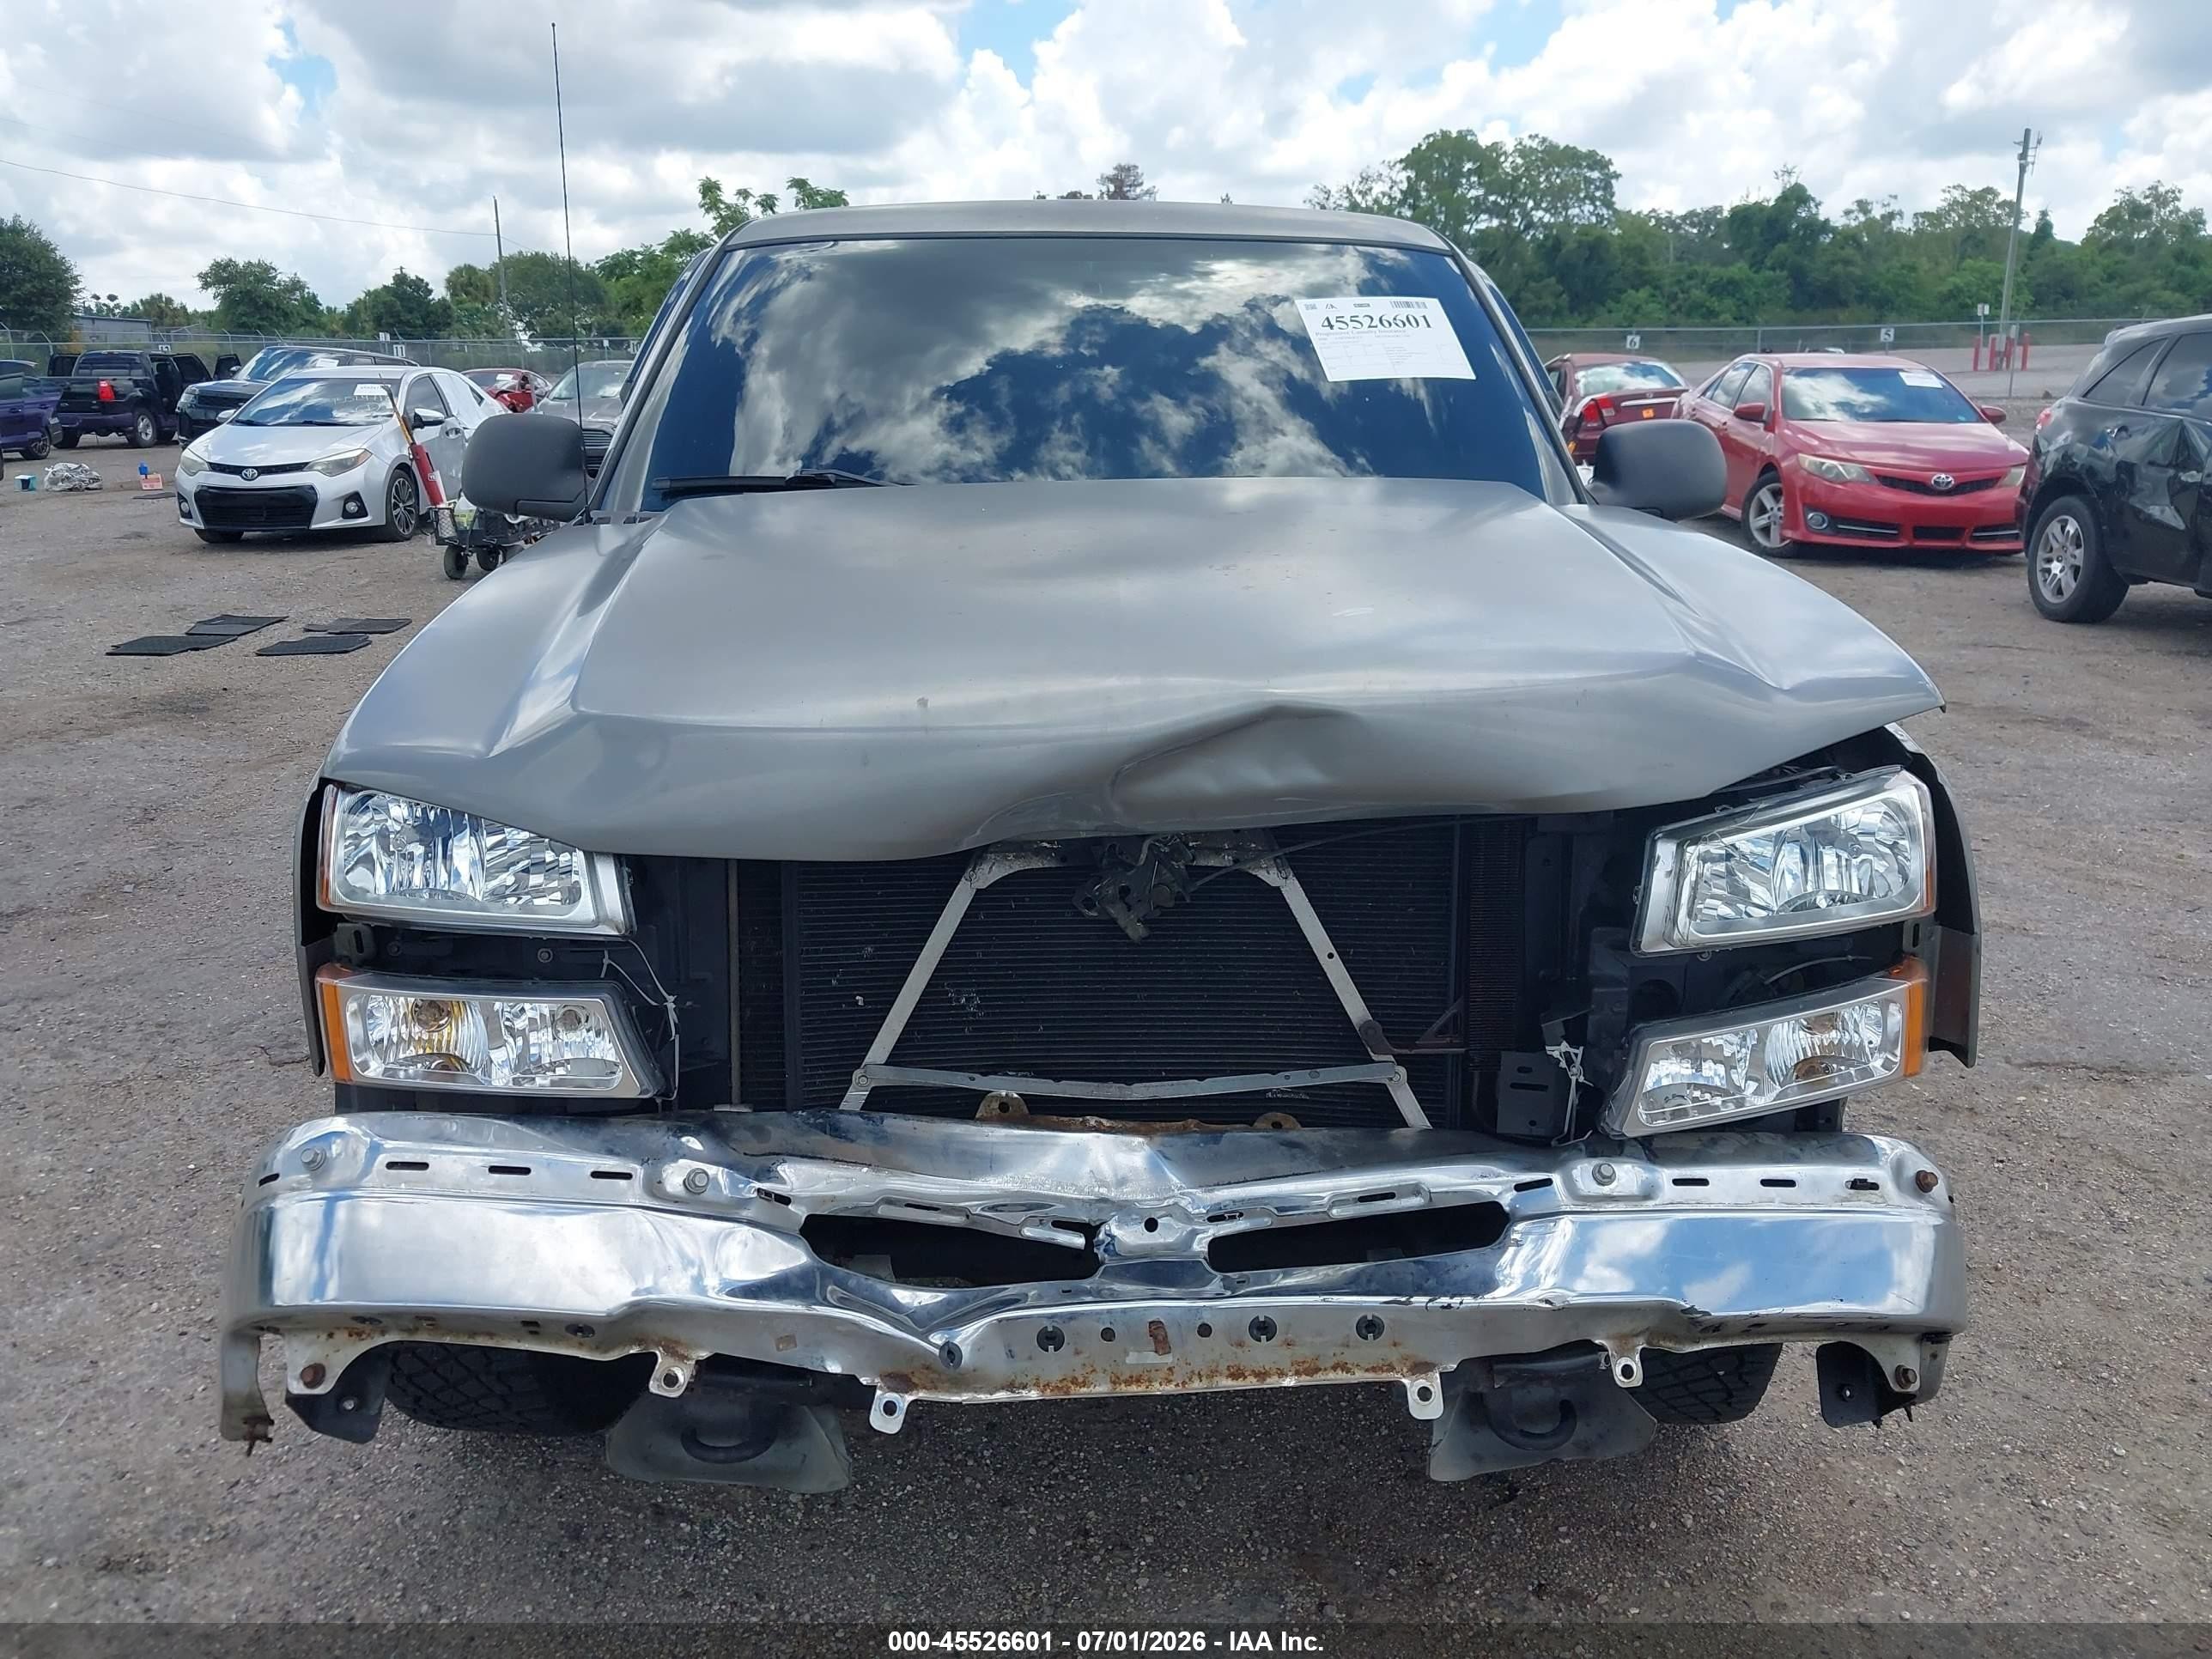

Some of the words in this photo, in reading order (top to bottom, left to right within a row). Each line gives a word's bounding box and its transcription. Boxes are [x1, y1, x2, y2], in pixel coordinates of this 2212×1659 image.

[1321, 313, 1432, 331] 45526601
[1883, 329, 1891, 341] 5
[1629, 337, 1637, 348] 6
